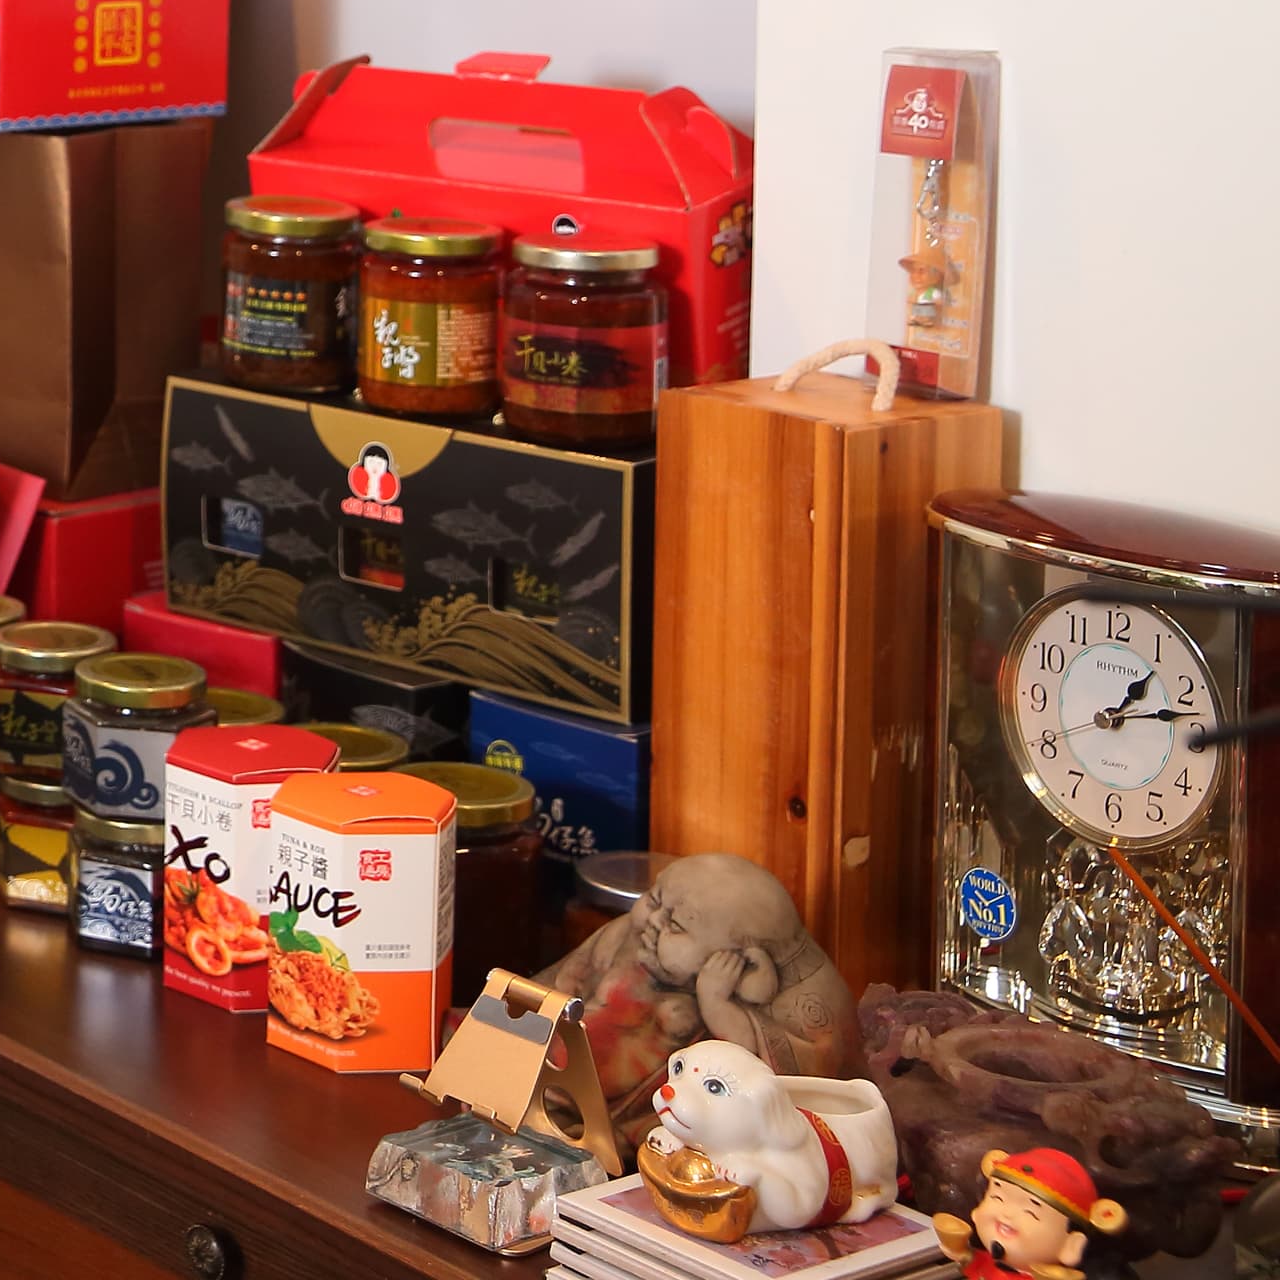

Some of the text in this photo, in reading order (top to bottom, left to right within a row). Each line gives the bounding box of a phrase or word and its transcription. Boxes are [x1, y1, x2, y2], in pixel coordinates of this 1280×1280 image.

[1069, 614, 1088, 646] 11
[1106, 610, 1132, 643] 12
[1040, 642, 1065, 674] 10
[1153, 633, 1162, 663] 1
[1096, 660, 1139, 678] RHYTHM
[1030, 683, 1047, 713] 9
[1177, 675, 1194, 707] 2
[1040, 729, 1057, 760] 8
[1068, 770, 1085, 799] 7
[1174, 767, 1193, 796] 4
[166, 792, 234, 833] 干貝小卷
[1104, 792, 1123, 824] 6
[1146, 791, 1164, 822] 5
[164, 823, 231, 885] XO
[278, 843, 329, 881] 親子醬
[968, 874, 1006, 896] WORLD
[967, 897, 1007, 927] No.1
